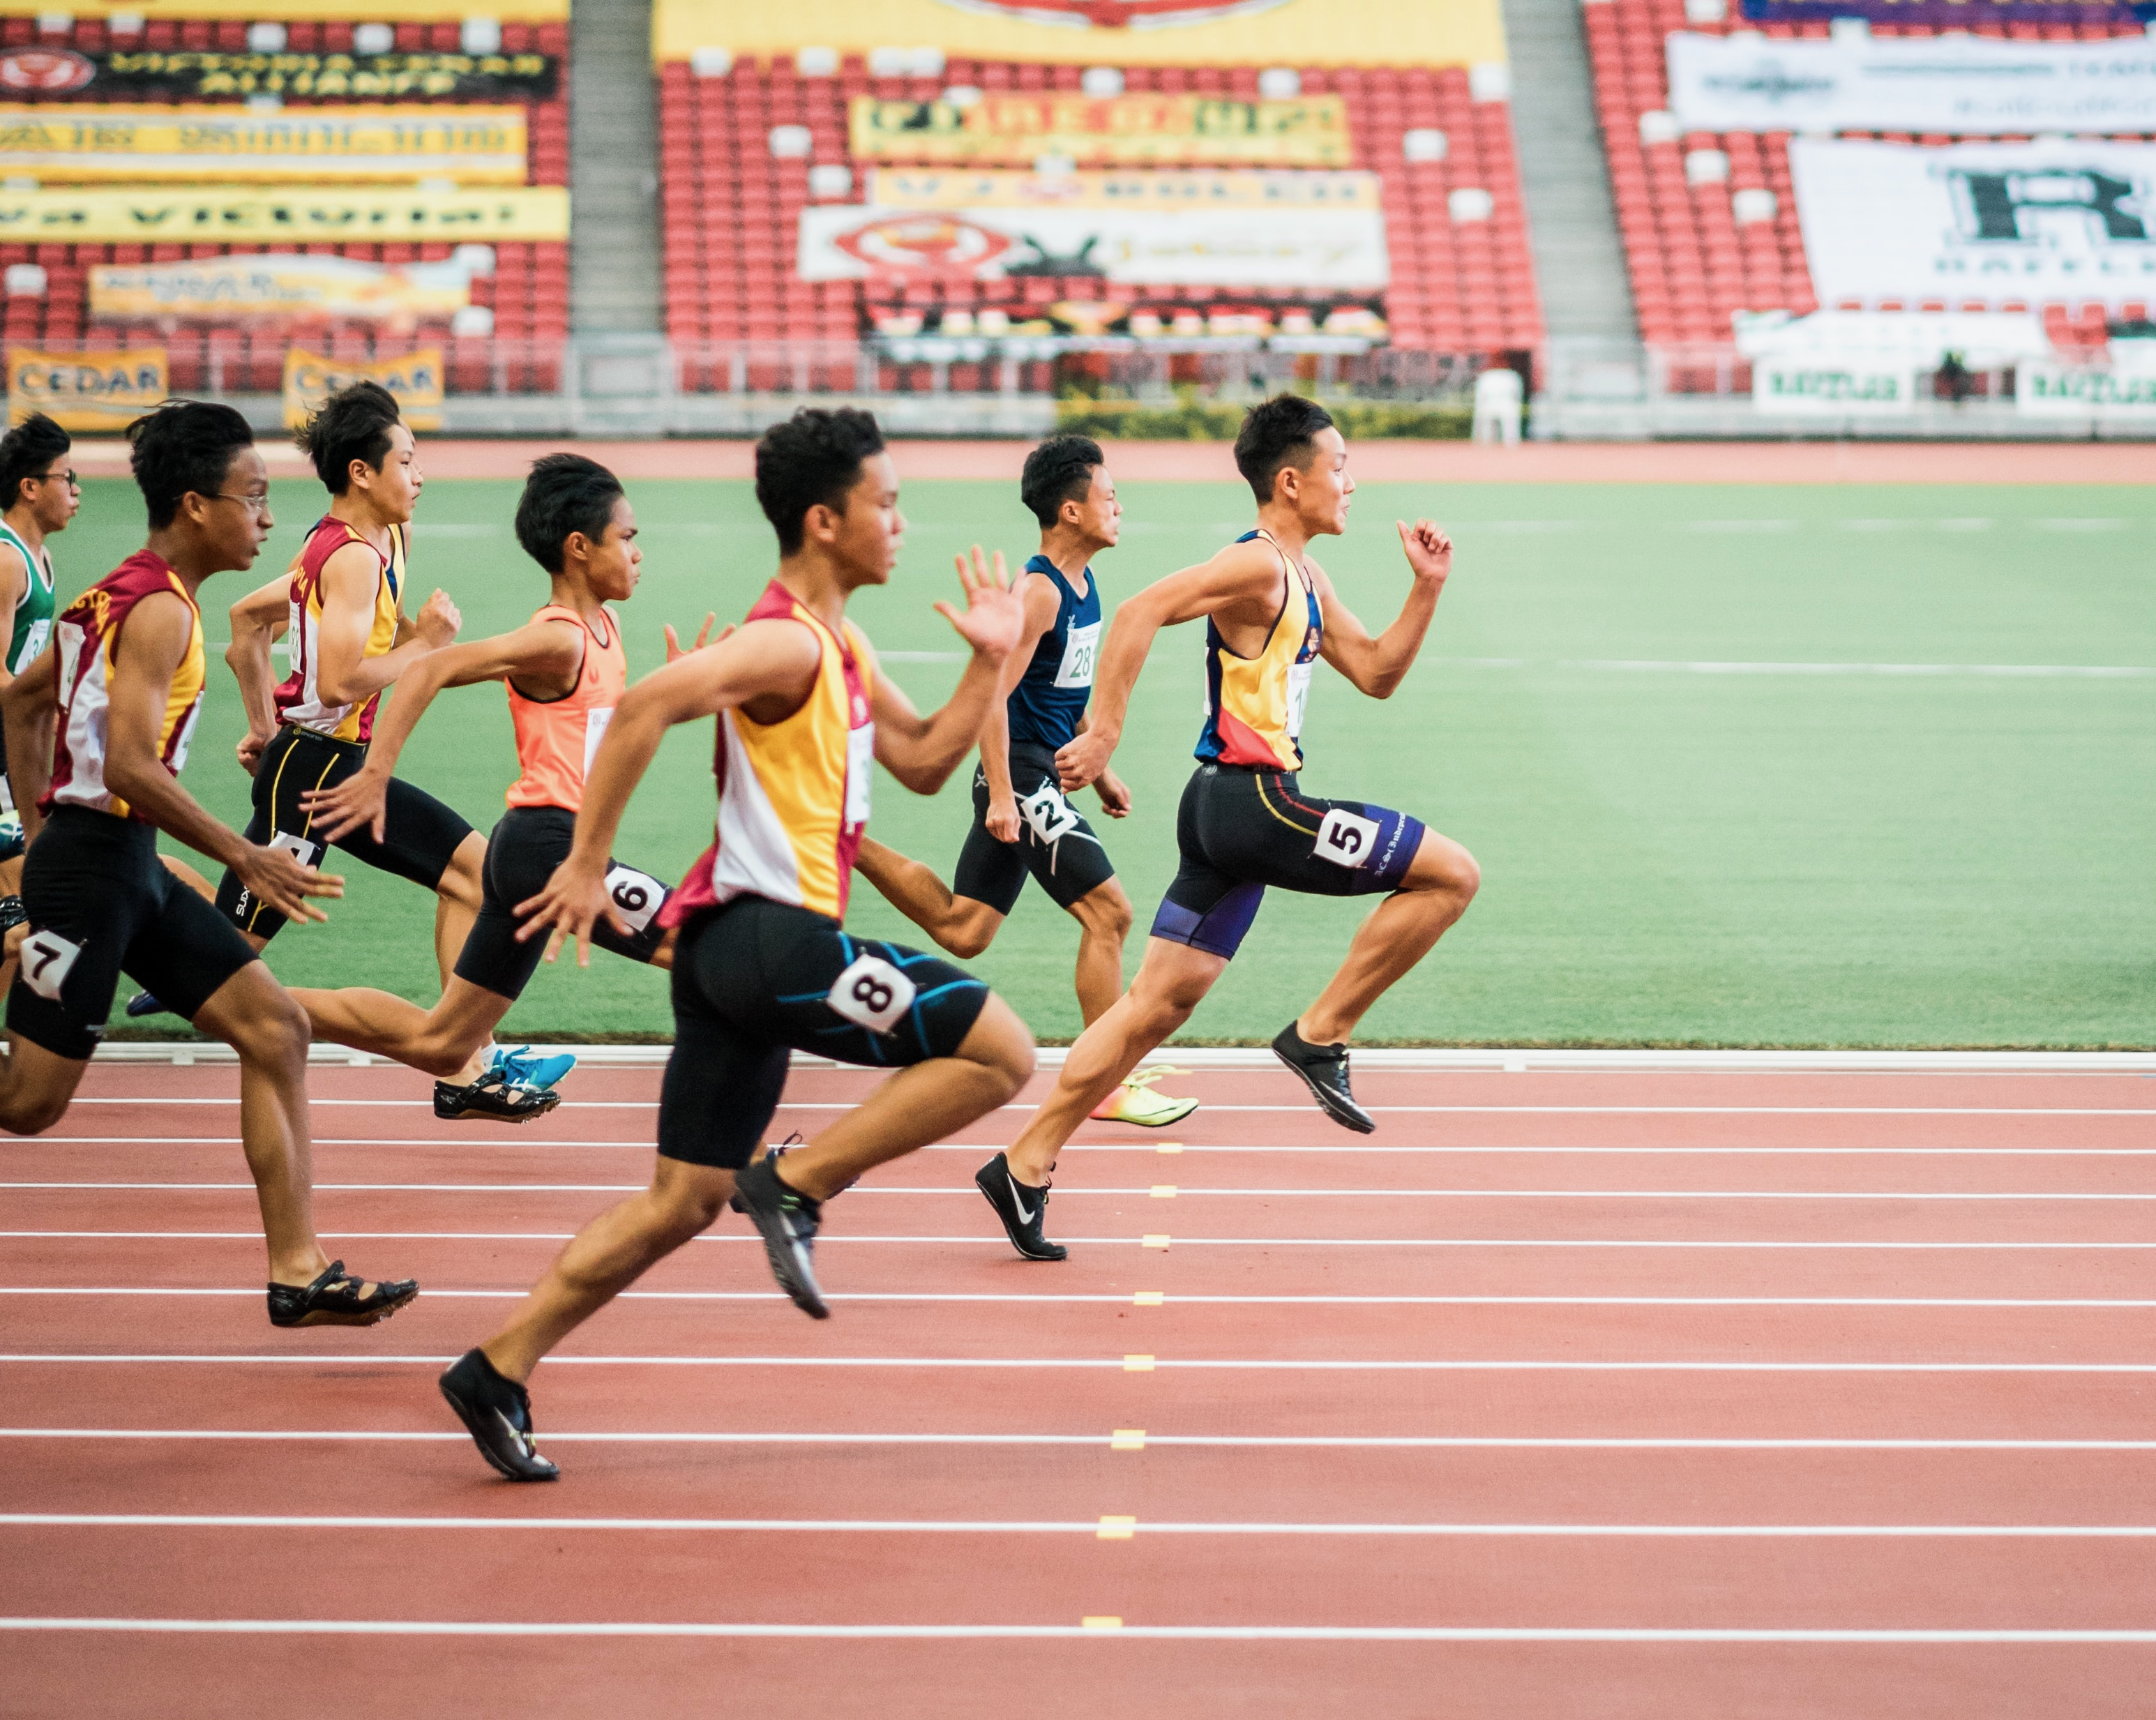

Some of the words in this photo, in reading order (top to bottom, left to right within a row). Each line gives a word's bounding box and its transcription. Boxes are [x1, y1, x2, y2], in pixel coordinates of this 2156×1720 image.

[1034, 800, 1065, 832] 2
[1328, 822, 1362, 854] 5
[612, 881, 649, 912] 6
[33, 941, 61, 981] 7
[852, 974, 893, 1013] 8
